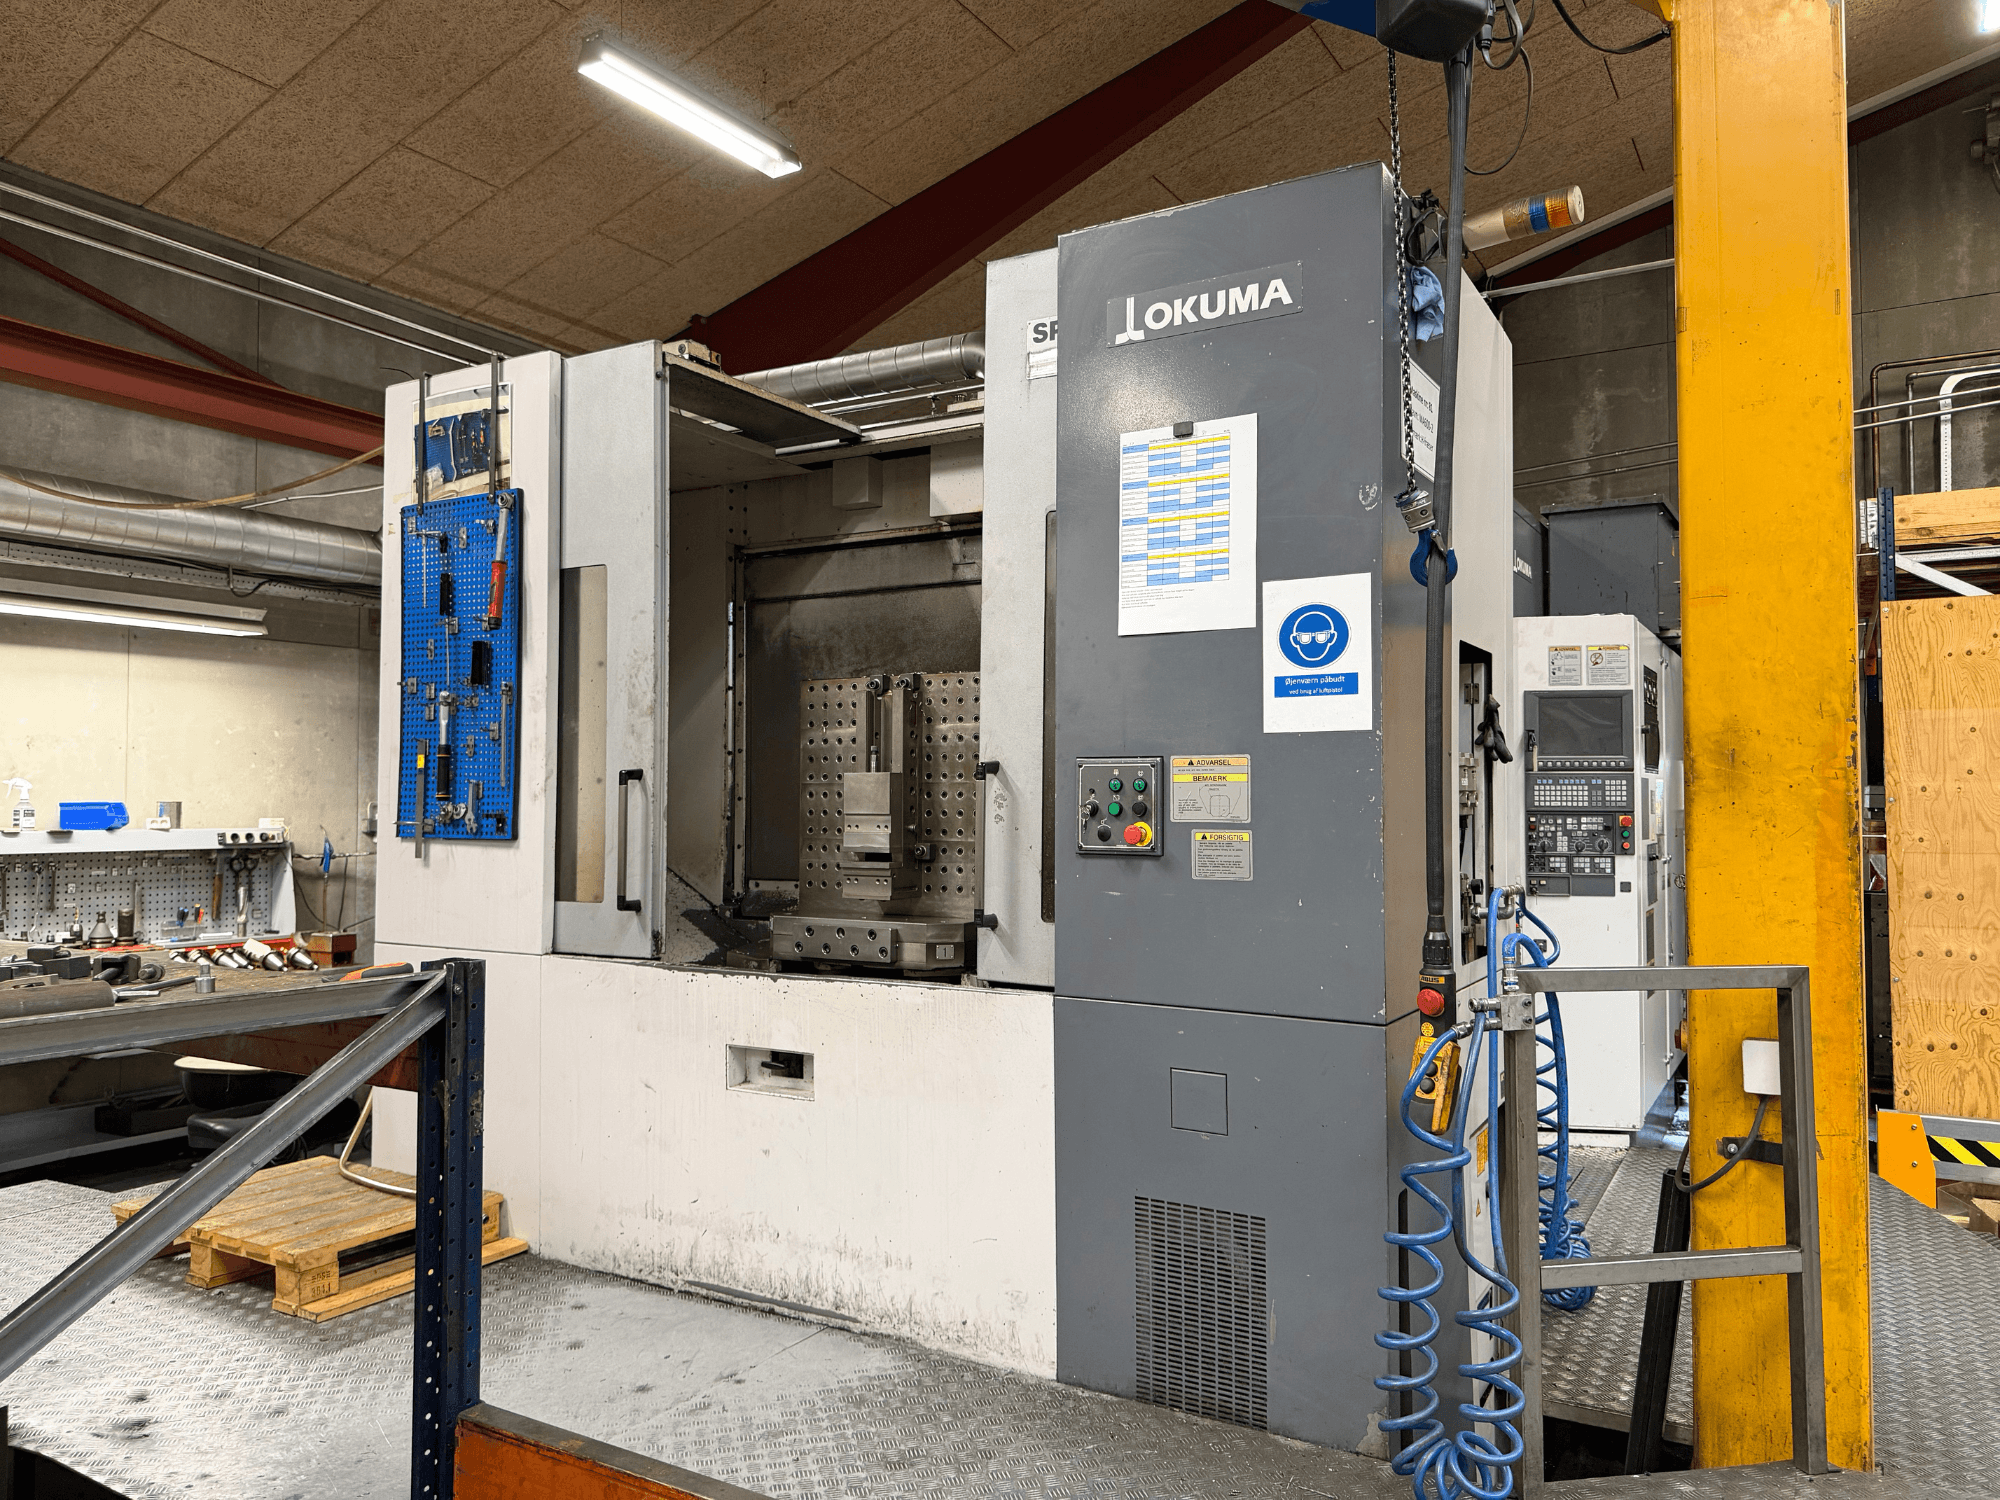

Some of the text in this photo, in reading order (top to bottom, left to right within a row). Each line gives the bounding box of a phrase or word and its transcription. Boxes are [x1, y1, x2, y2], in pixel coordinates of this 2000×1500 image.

[1144, 278, 1293, 330] OKUMA
[1285, 675, 1345, 686] Øjenværn påbudt
